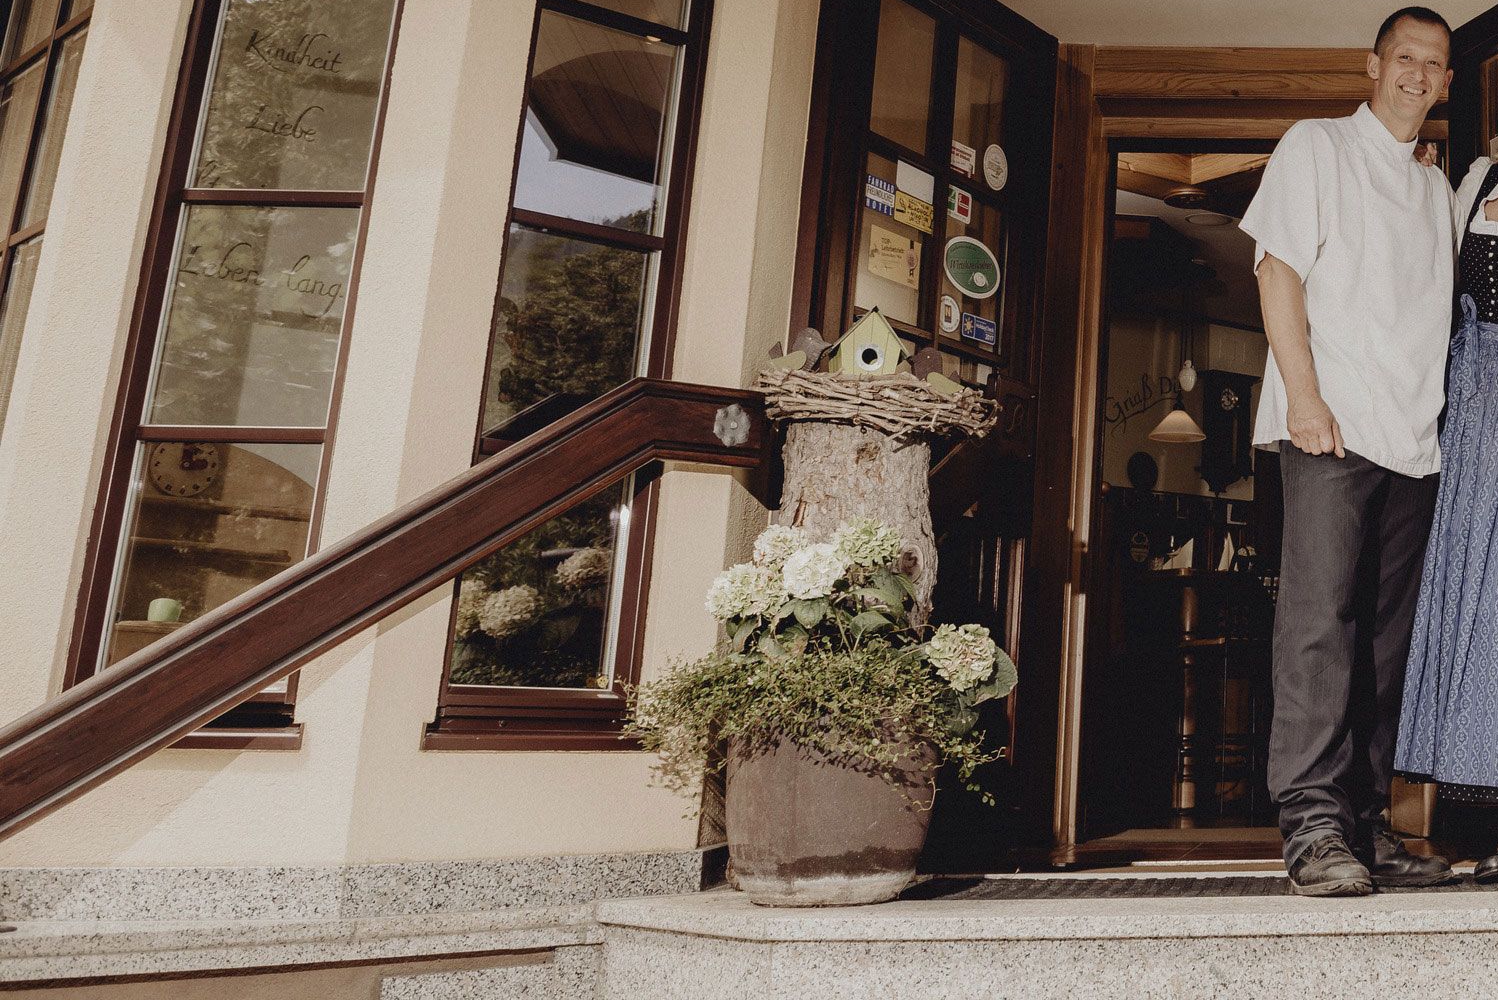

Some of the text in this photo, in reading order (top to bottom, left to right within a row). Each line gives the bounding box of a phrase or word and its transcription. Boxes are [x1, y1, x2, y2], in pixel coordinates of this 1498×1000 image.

[244, 29, 343, 75] Kindheit
[245, 104, 325, 143] Liebe
[868, 175, 895, 193] FAHRRAD
[866, 198, 893, 216] HOTEL
